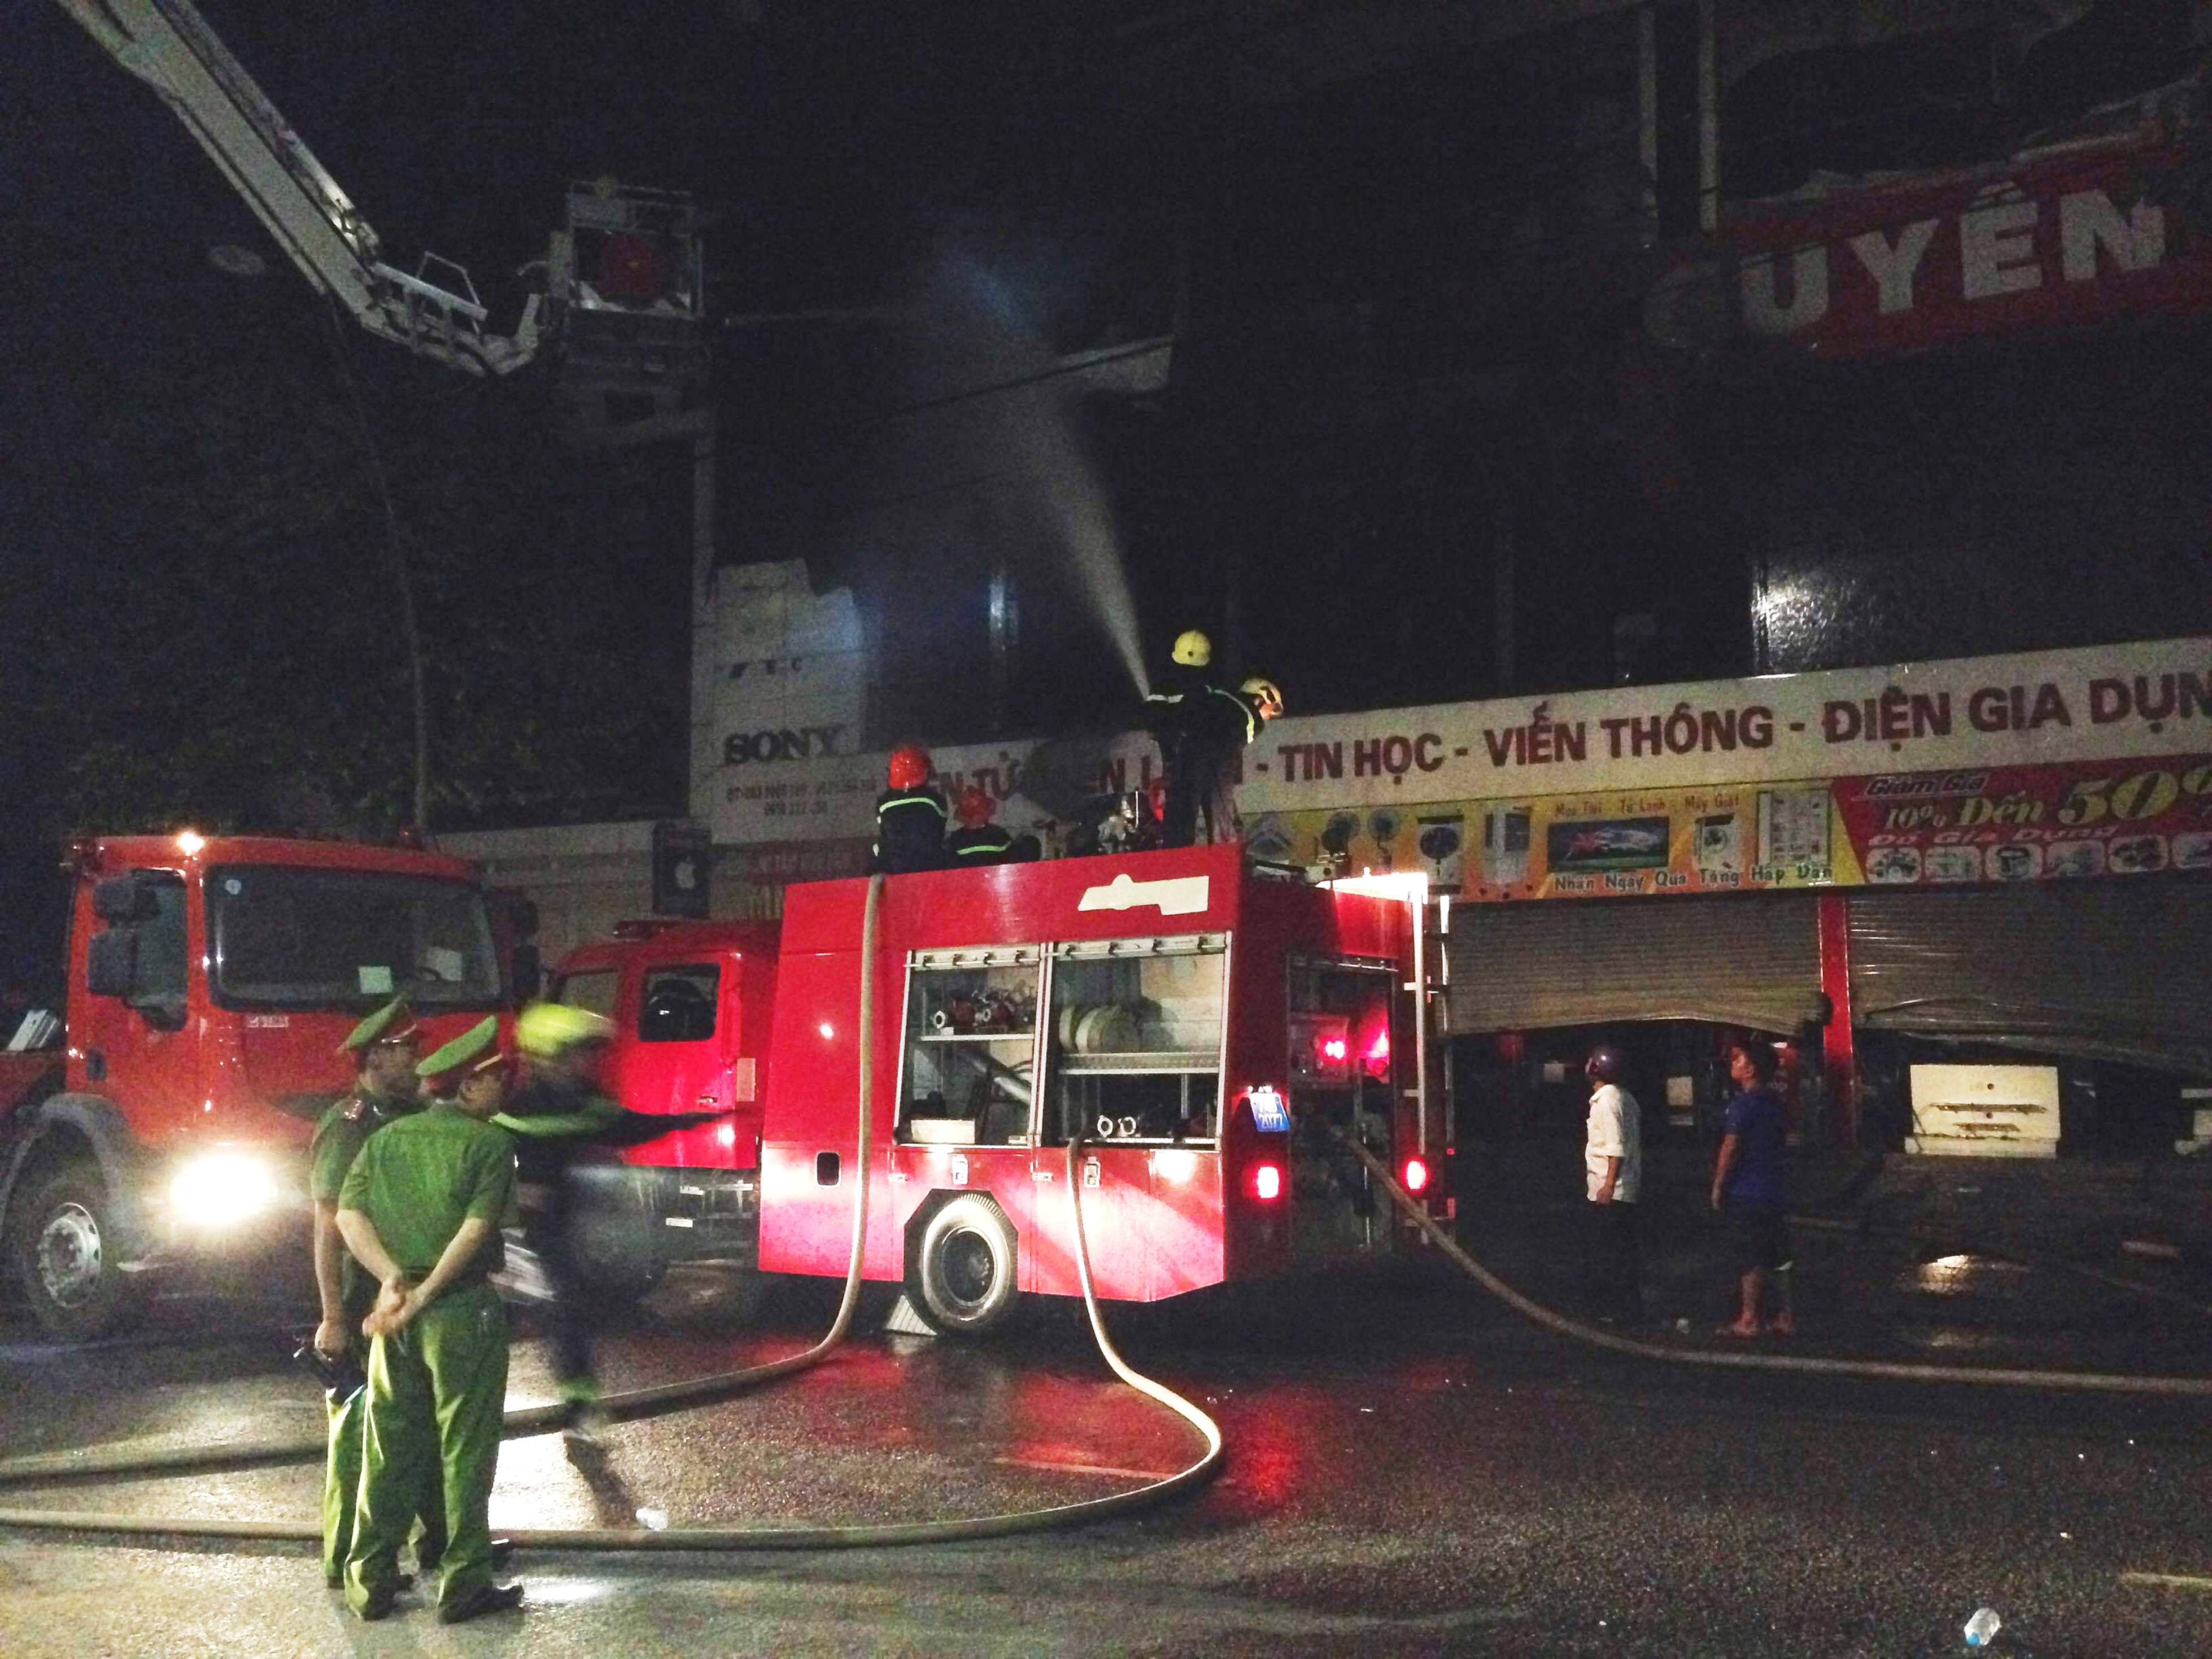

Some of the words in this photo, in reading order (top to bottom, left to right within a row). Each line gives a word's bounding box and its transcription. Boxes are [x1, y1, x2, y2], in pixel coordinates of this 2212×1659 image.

[1644, 180, 2166, 342] UYÊN
[725, 723, 848, 763] SONY
[1278, 741, 1343, 782] TIN
[1354, 734, 1445, 784] HỌC
[1600, 702, 1773, 758] THÔNG
[1821, 685, 1952, 752] ĐIỆN
[1968, 683, 2071, 732] GIA
